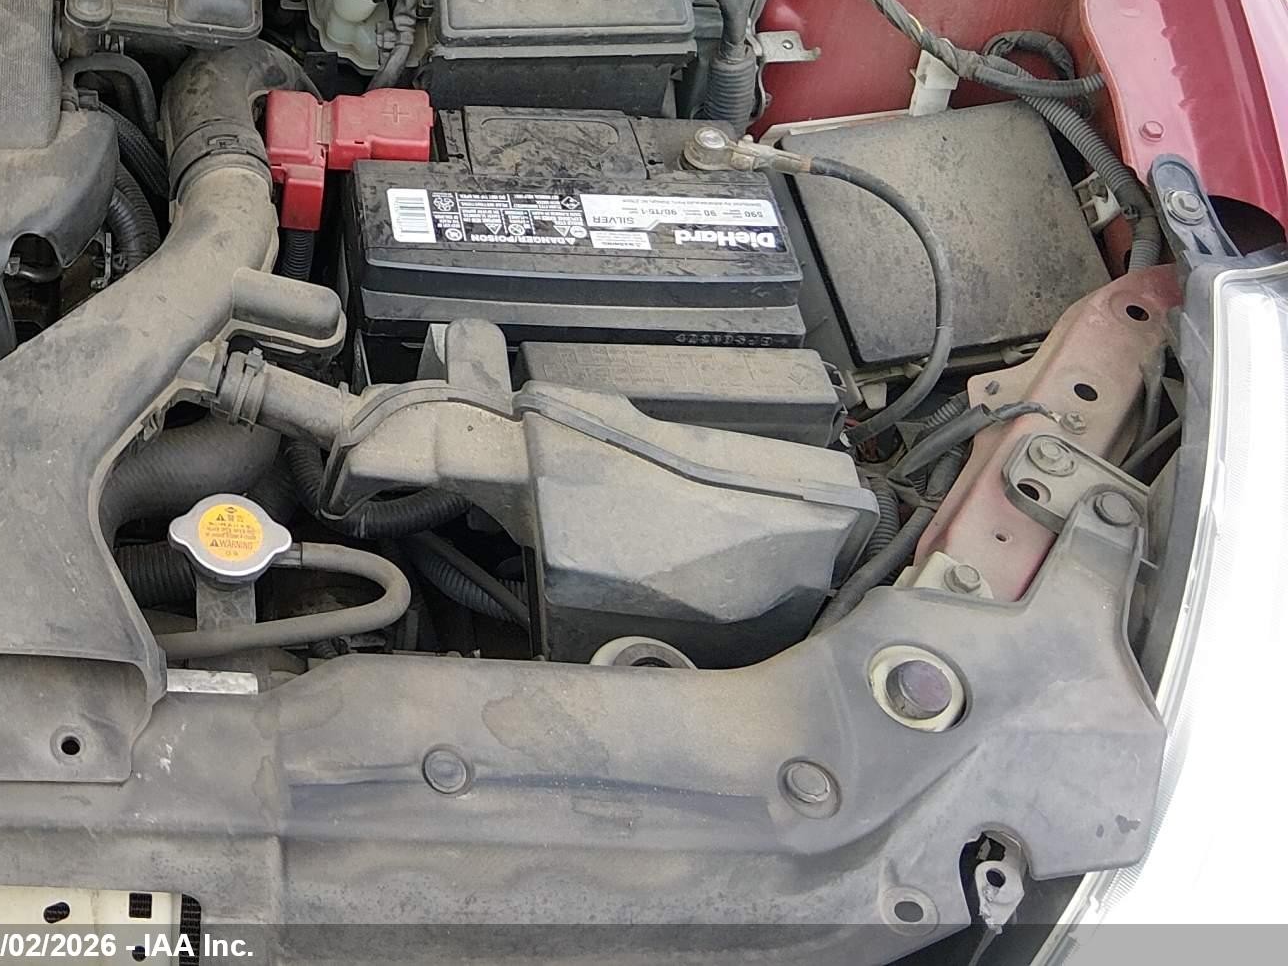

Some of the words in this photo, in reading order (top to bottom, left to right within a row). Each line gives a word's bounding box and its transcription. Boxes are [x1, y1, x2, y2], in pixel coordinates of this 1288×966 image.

[744, 210, 764, 218] 590
[591, 214, 635, 226] SILVER
[472, 234, 569, 244] DANGER/POISON
[674, 229, 776, 249] DieHard
[219, 539, 254, 550] WARNING
